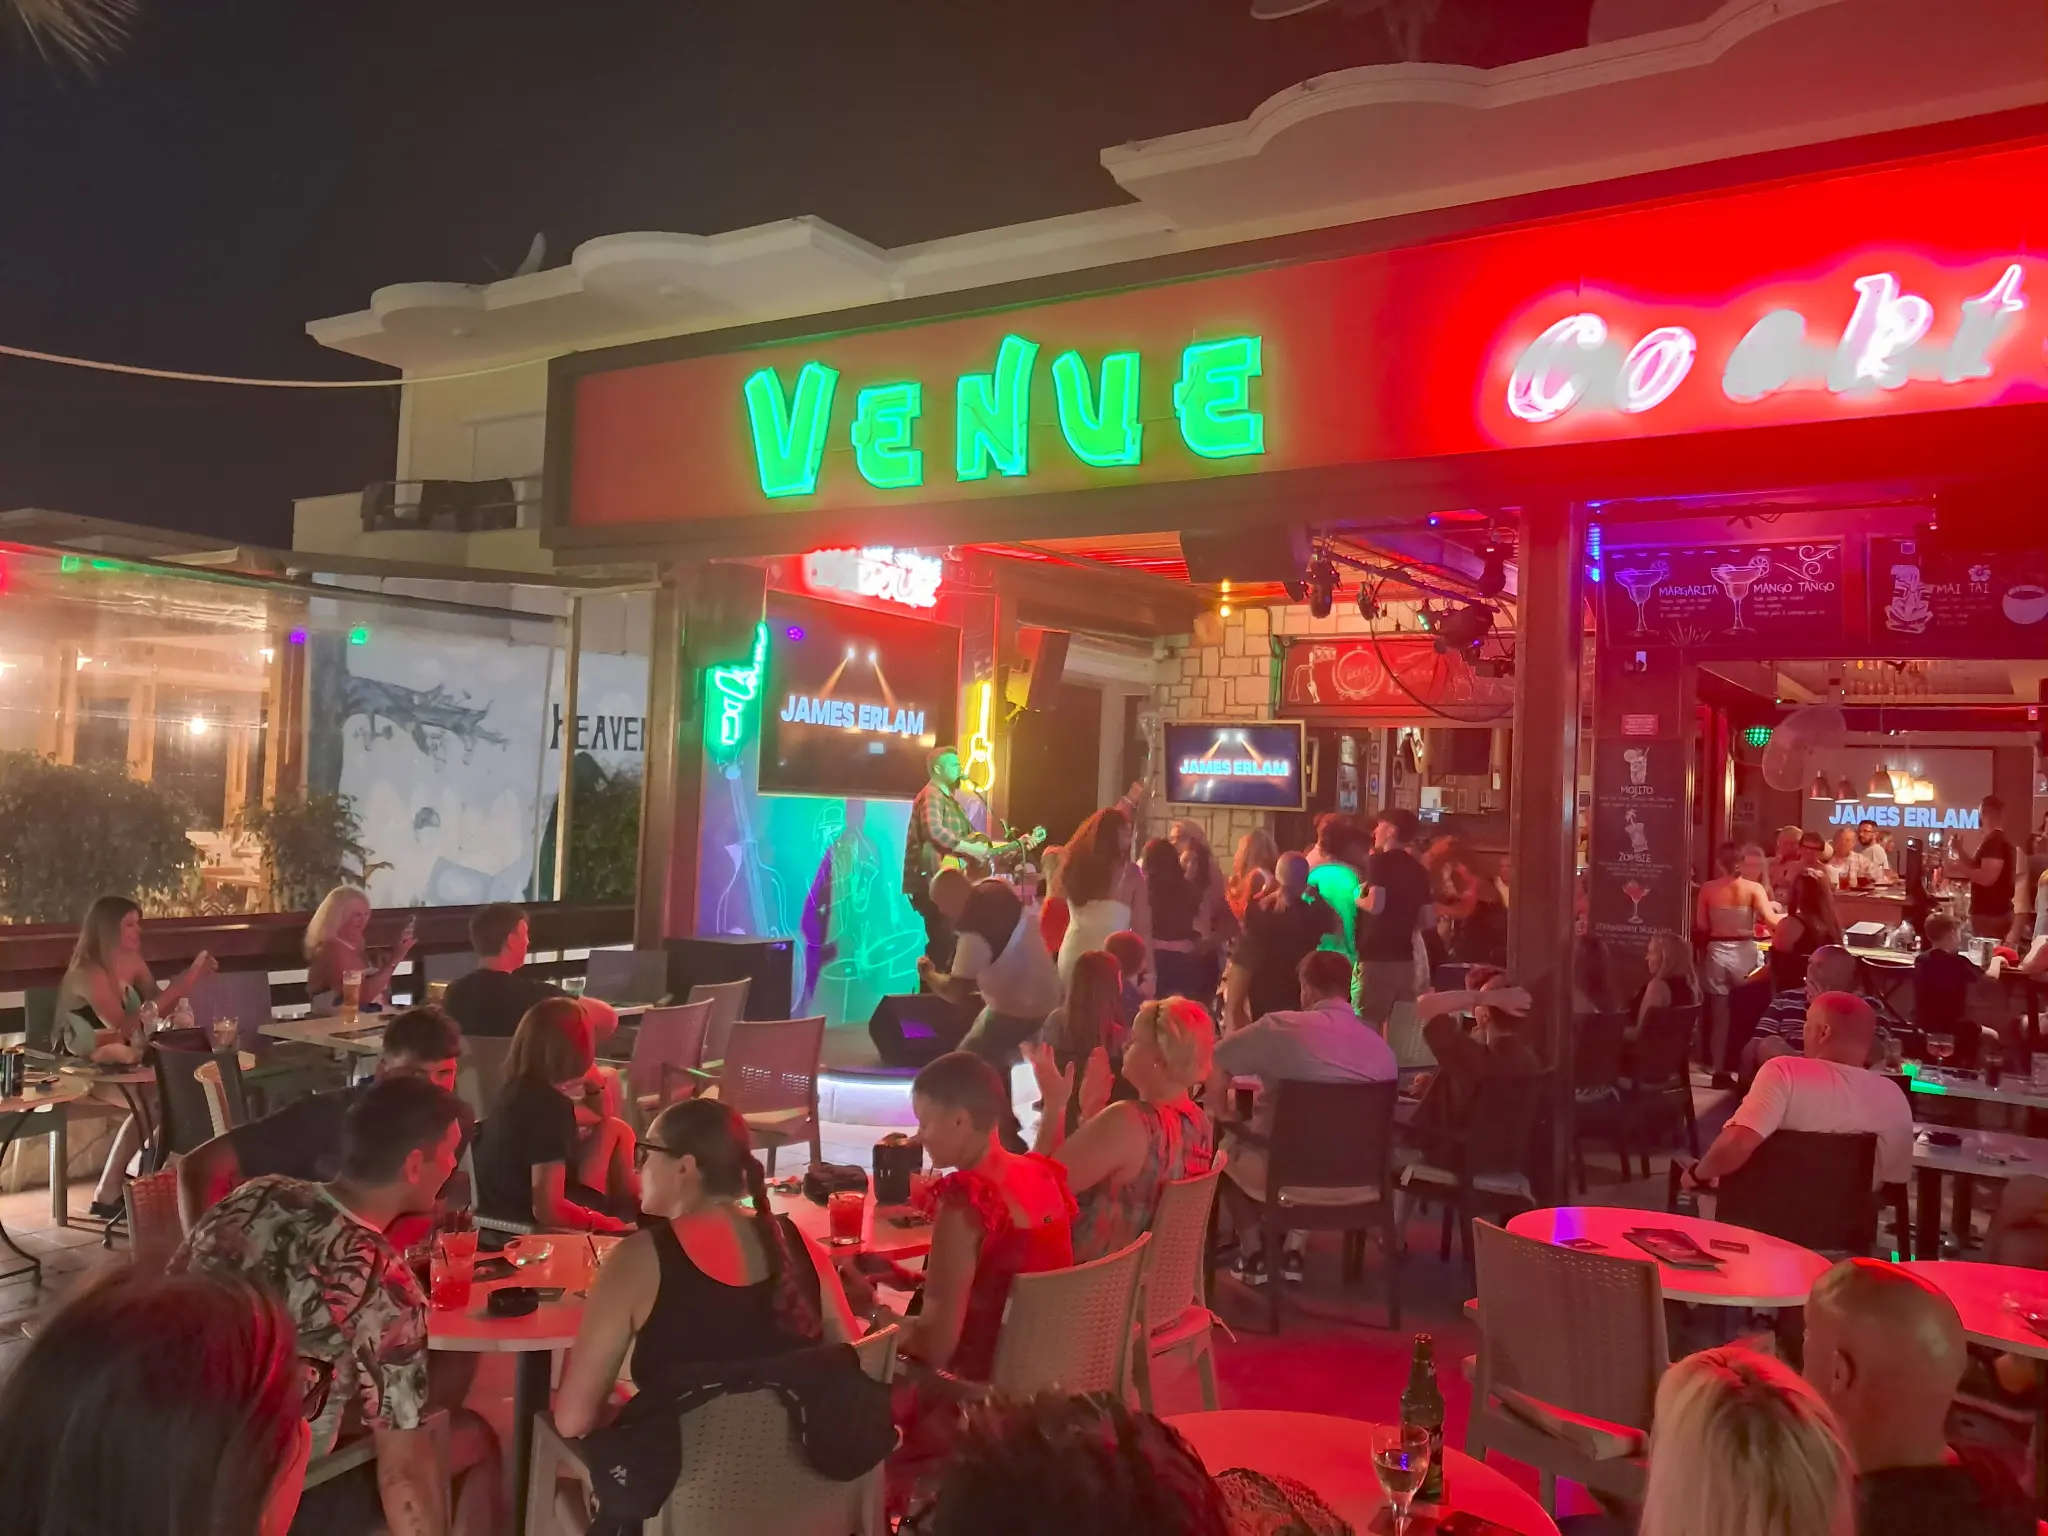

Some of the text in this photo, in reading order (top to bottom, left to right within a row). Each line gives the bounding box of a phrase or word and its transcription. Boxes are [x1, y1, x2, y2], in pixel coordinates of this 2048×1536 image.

[1508, 265, 2048, 422] Cokt
[744, 334, 1266, 498] VENUE
[1658, 584, 1719, 597] MARGARITA
[1753, 582, 1835, 594] MANGO TANGO
[1936, 582, 1989, 595] MAI TAI
[780, 694, 925, 736] JAMES ERLAM
[1179, 758, 1290, 777] JAMES ERLAM
[1620, 785, 1654, 798] MOJITO
[1829, 804, 1980, 830] JAMES ERLAM
